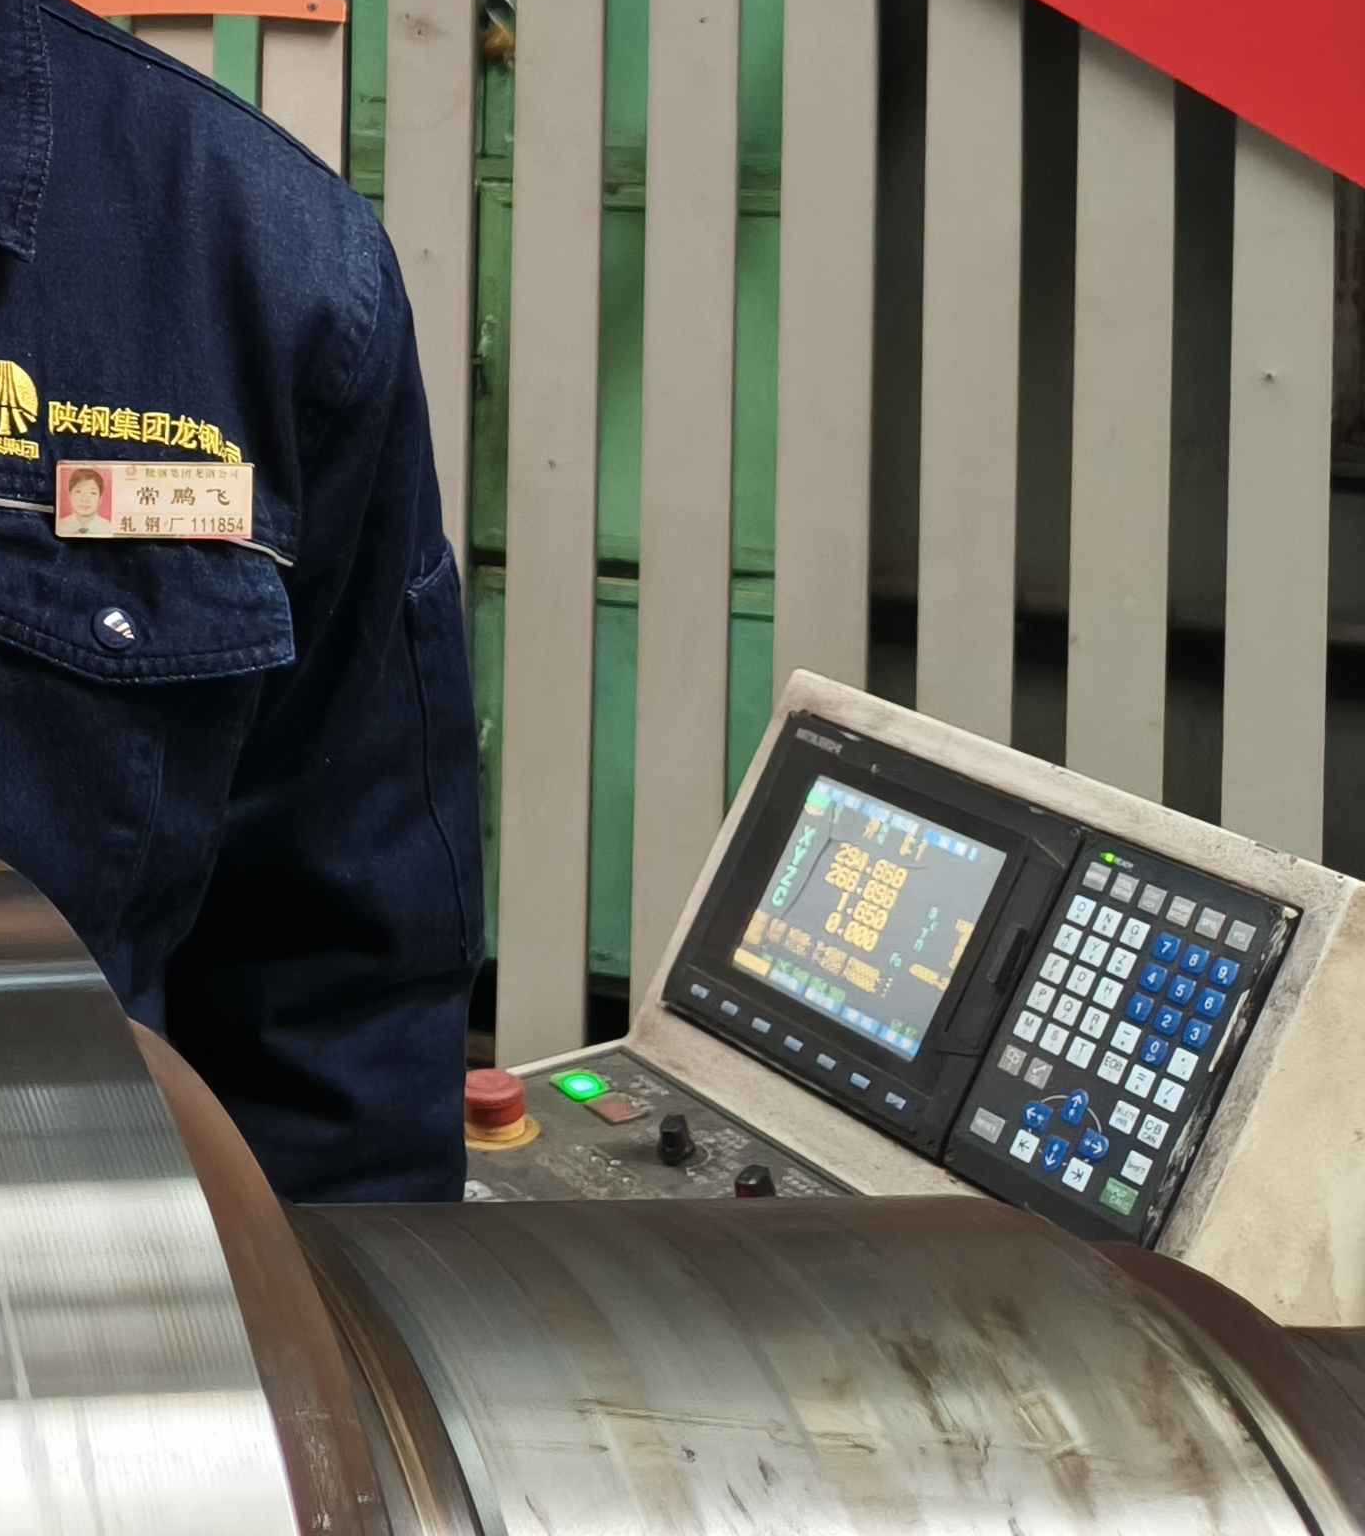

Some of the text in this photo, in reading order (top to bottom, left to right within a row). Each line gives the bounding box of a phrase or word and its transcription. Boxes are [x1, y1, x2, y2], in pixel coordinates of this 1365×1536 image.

[136, 486, 230, 506] 常鹏飞
[120, 515, 244, 533] 轧钢厂 111854
